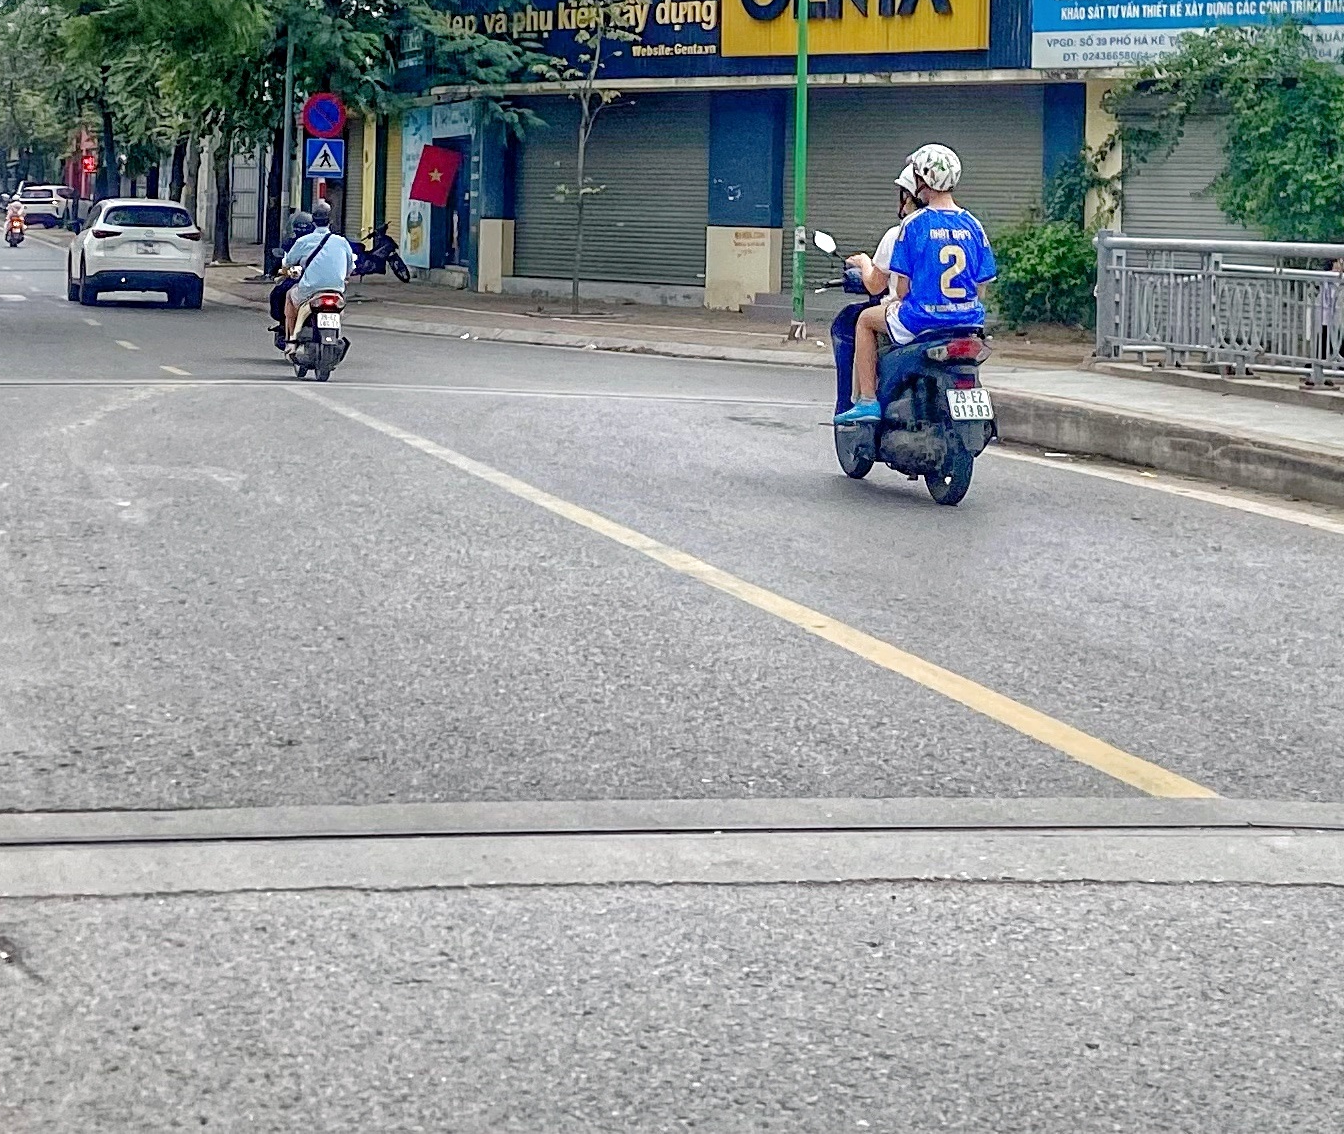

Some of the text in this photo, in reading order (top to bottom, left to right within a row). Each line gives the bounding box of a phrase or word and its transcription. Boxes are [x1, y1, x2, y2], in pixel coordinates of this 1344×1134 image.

[512, 4, 553, 39] phụ
[1087, 3, 1105, 19] SÁT
[1184, 0, 1204, 17] XÂY
[939, 244, 967, 299] 2
